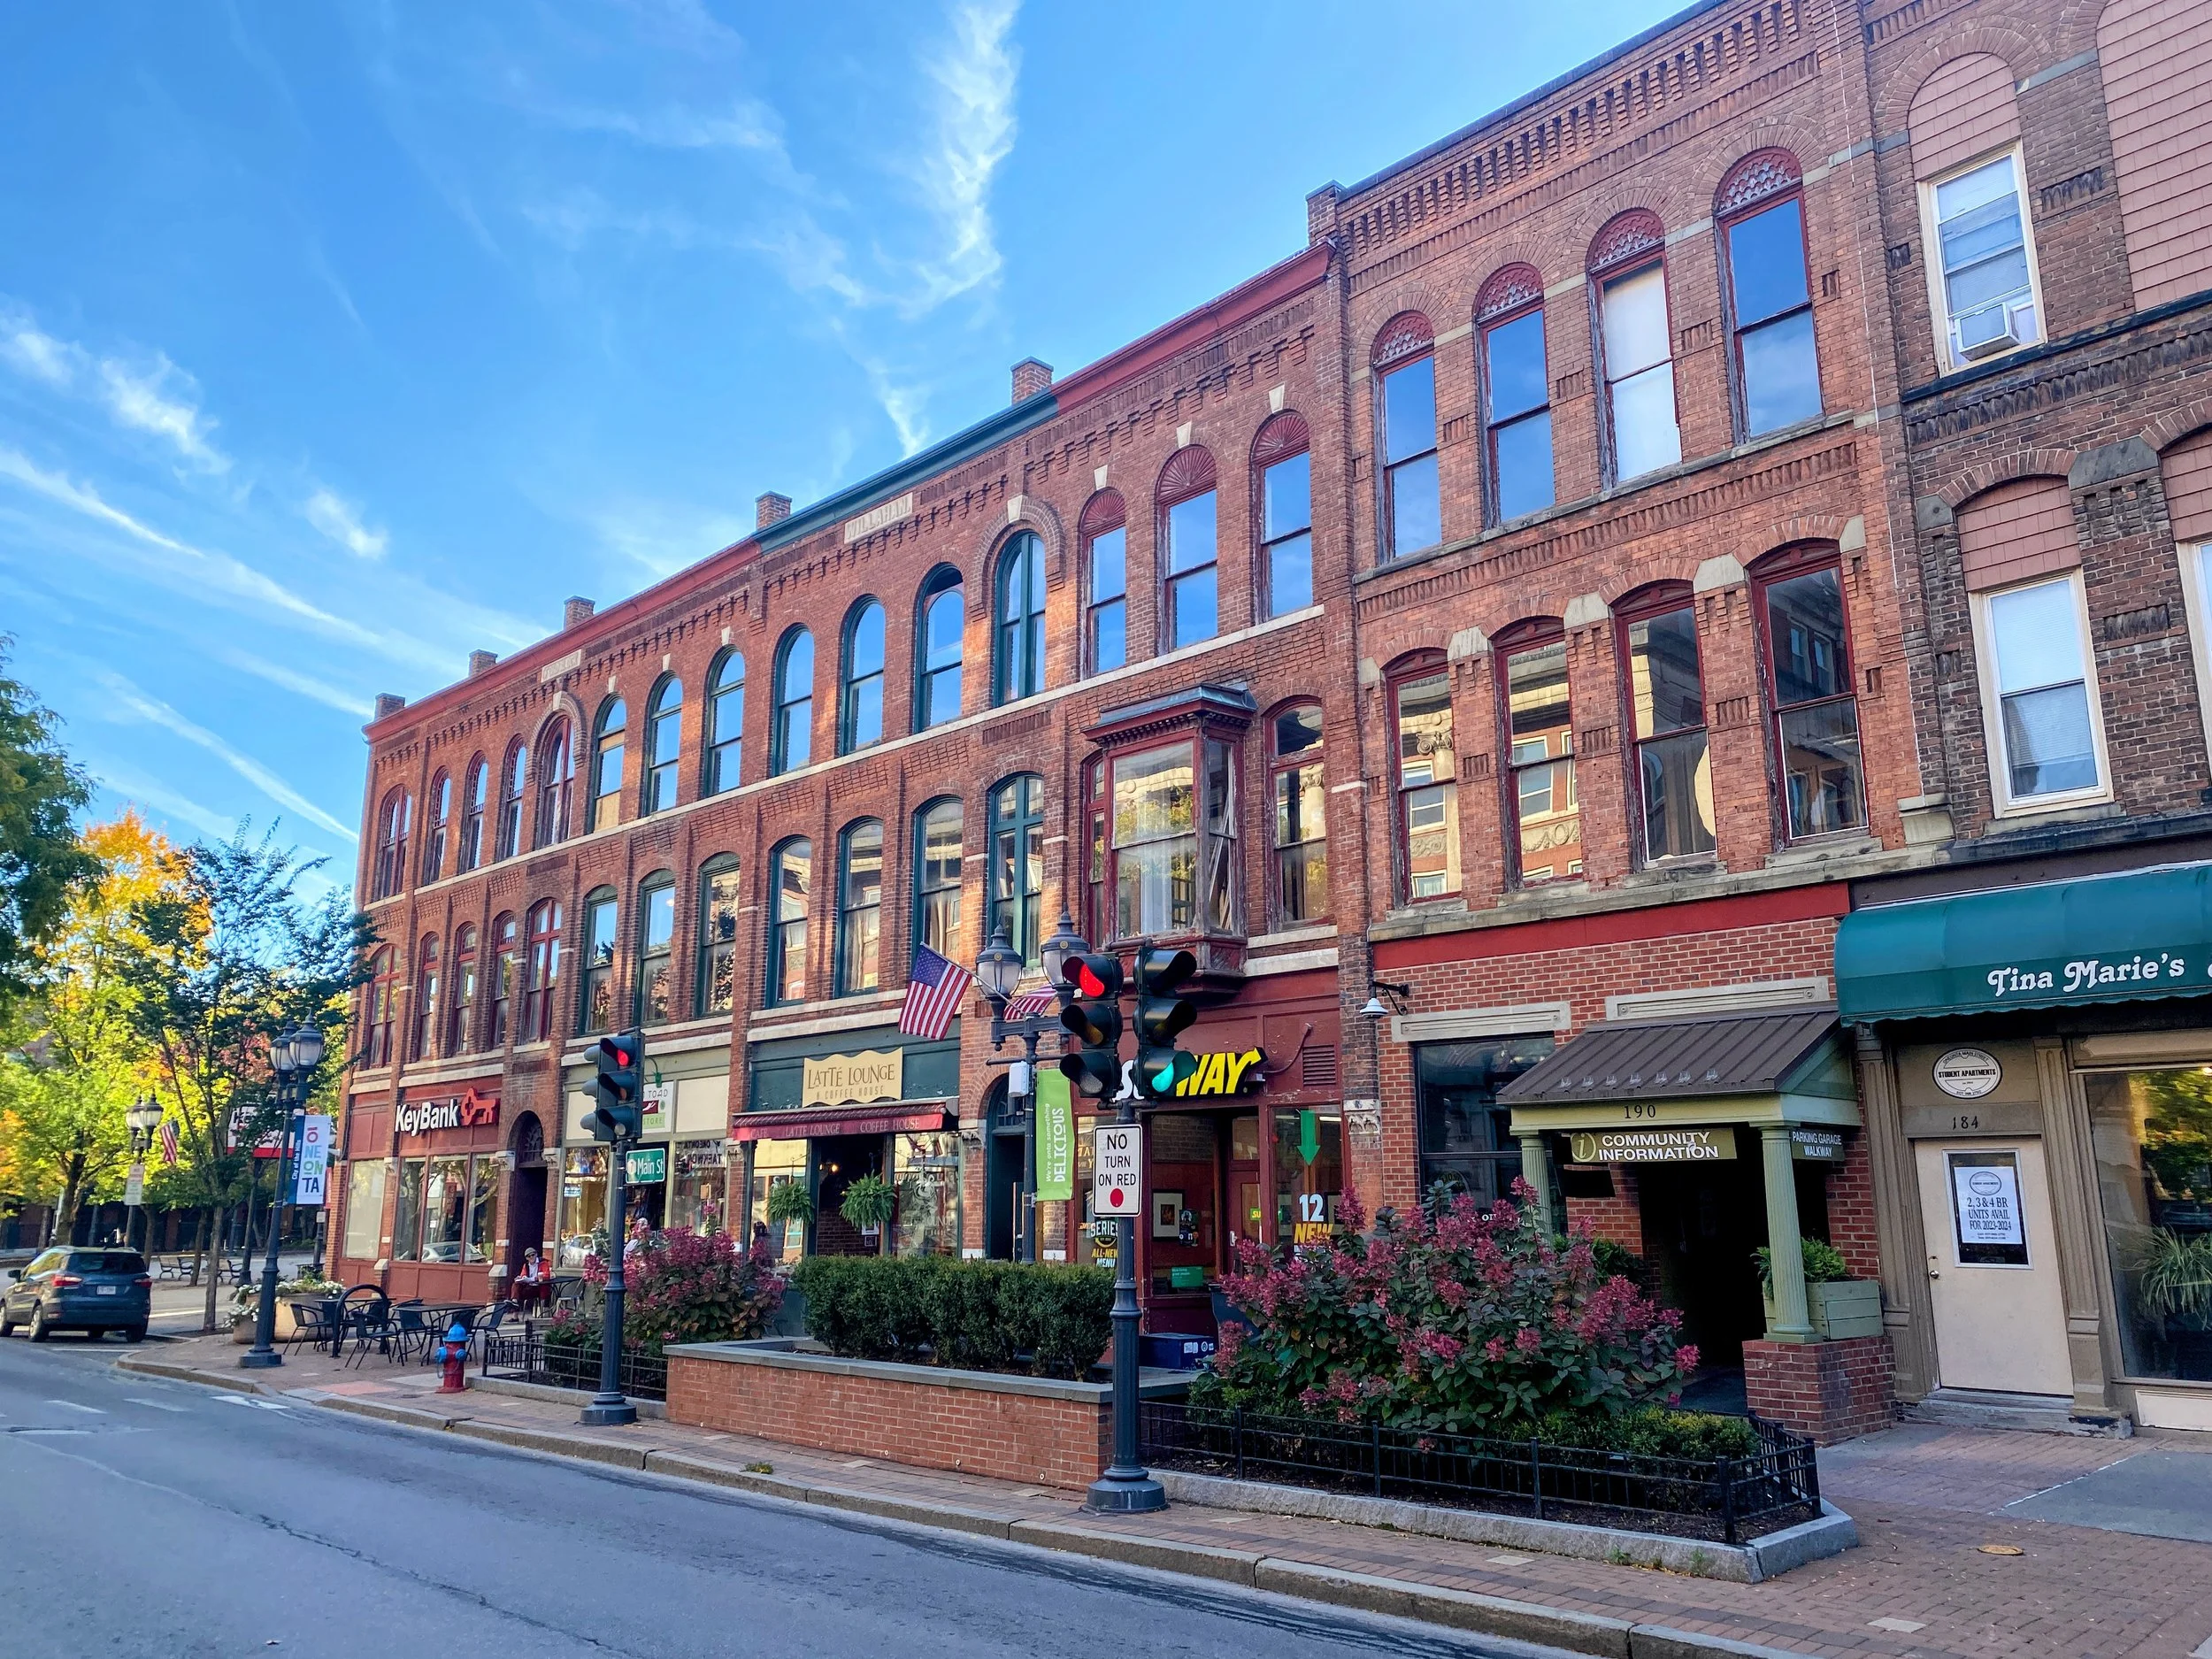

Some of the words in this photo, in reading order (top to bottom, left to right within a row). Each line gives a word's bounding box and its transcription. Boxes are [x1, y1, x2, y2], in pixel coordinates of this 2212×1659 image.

[1987, 966, 2054, 997] Tina
[2062, 953, 2185, 993] Marie's
[849, 1064, 895, 1086] LOUNGE
[1112, 1047, 1261, 1102] SWAY
[648, 1088, 668, 1098] TOAD
[825, 1088, 853, 1099] COFFEE
[858, 1086, 884, 1096] HOUSE
[395, 1099, 459, 1137] KeyBank
[1624, 1104, 1656, 1119] 190
[809, 1123, 840, 1136] LOUNGE
[860, 1120, 888, 1133] COFFEE
[893, 1118, 919, 1130] HOUSE
[1953, 1116, 1978, 1130] 184
[1051, 1108, 1067, 1182] DELICIOUS
[1107, 1133, 1127, 1150] NO
[1601, 1132, 1710, 1147] COMMUNITY
[1792, 1131, 1817, 1143] PARKING
[1817, 1133, 1842, 1145] GARAGE
[1599, 1146, 1719, 1161] INFORMATION
[1803, 1145, 1832, 1157] WALKWAY
[637, 1157, 655, 1175] Main
[656, 1159, 664, 1174] St
[1105, 1156, 1131, 1168] TURN
[1098, 1173, 1111, 1187] ON
[1118, 1173, 1136, 1186] RED
[1299, 1194, 1324, 1222] 12
[1996, 1197, 2008, 1208] BR
[1968, 1210, 1989, 1219] UNITS
[1992, 1210, 2010, 1219] AVAIL
[1970, 1220, 1982, 1230] FOR
[1983, 1220, 2011, 1231] 2023-2024
[1096, 1258, 1116, 1268] MENU
